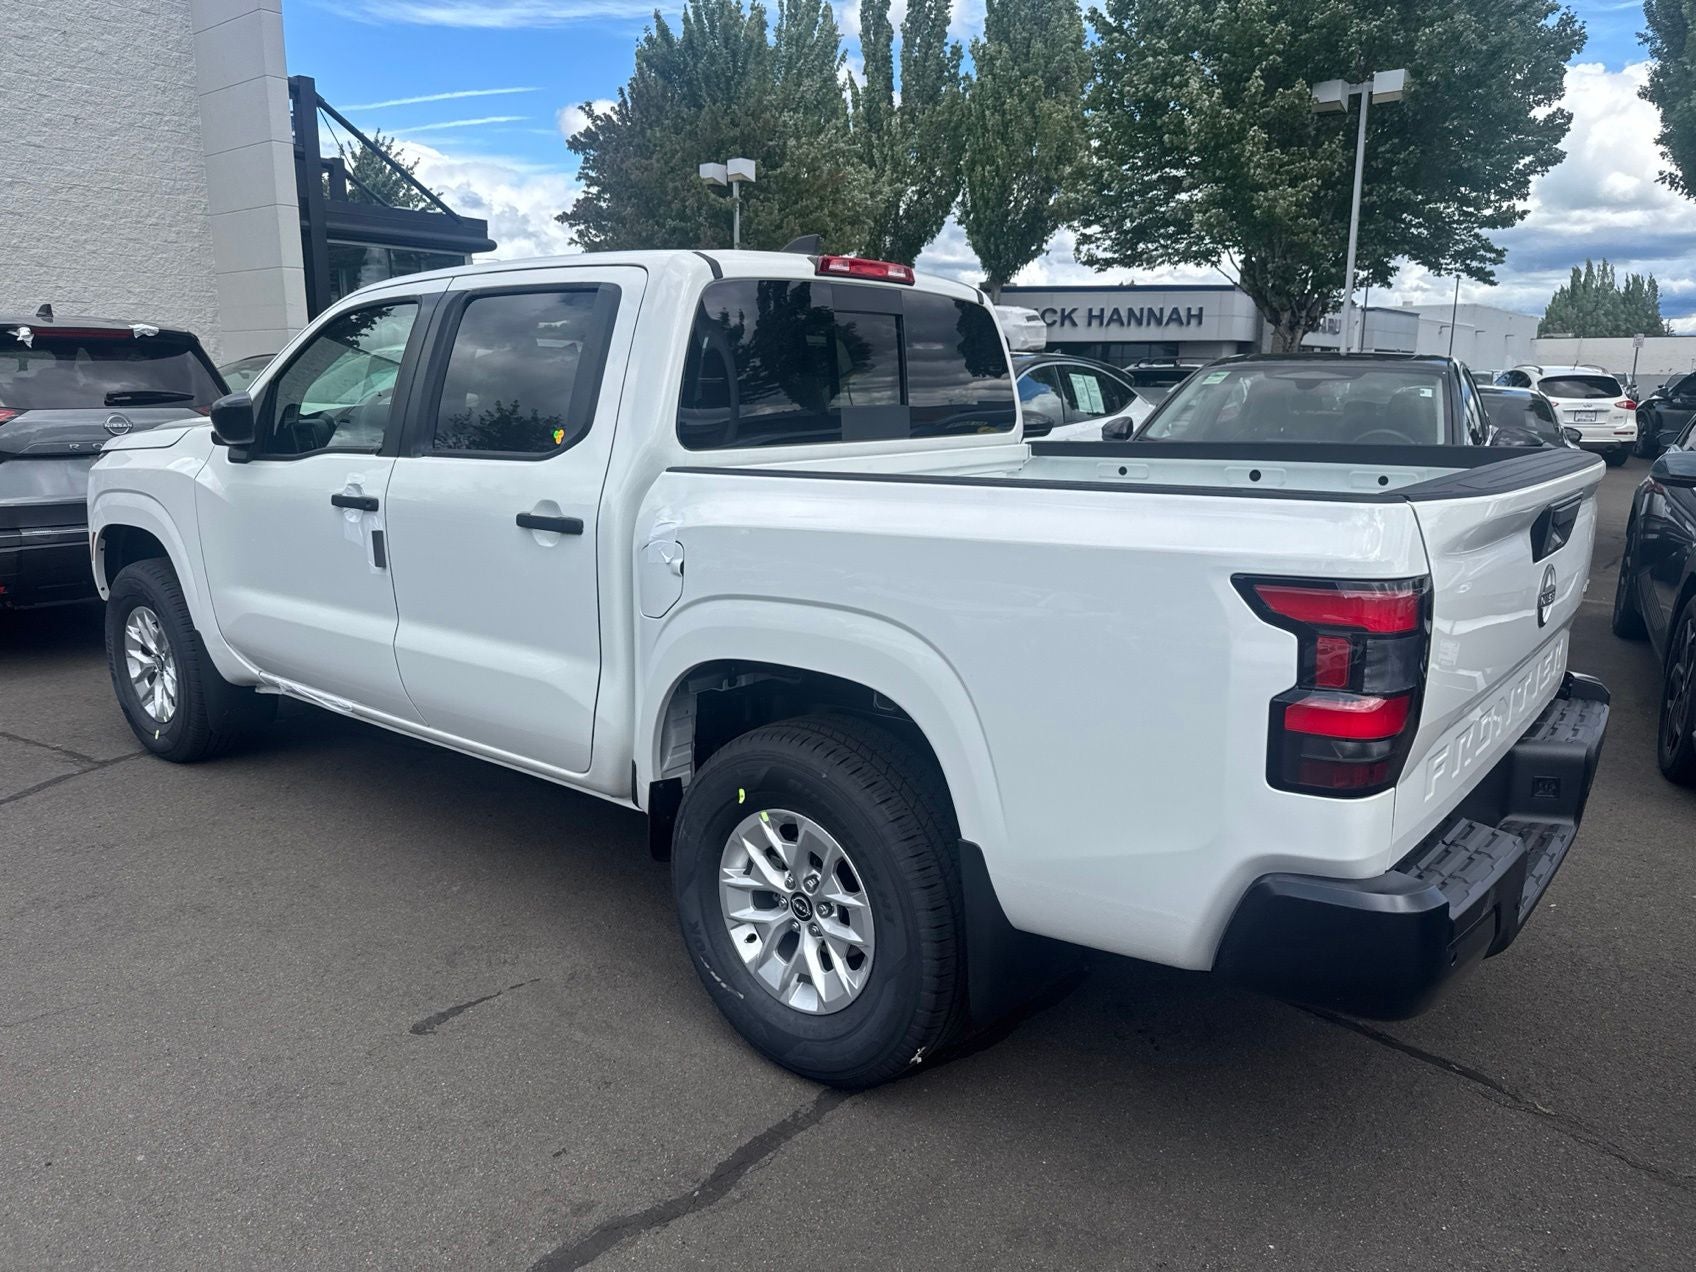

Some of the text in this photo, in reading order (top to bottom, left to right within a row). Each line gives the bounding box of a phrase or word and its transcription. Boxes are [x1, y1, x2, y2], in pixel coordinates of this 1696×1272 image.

[1034, 306, 1204, 327] CK HANNAH
[1424, 638, 1563, 802] FRONTIER
